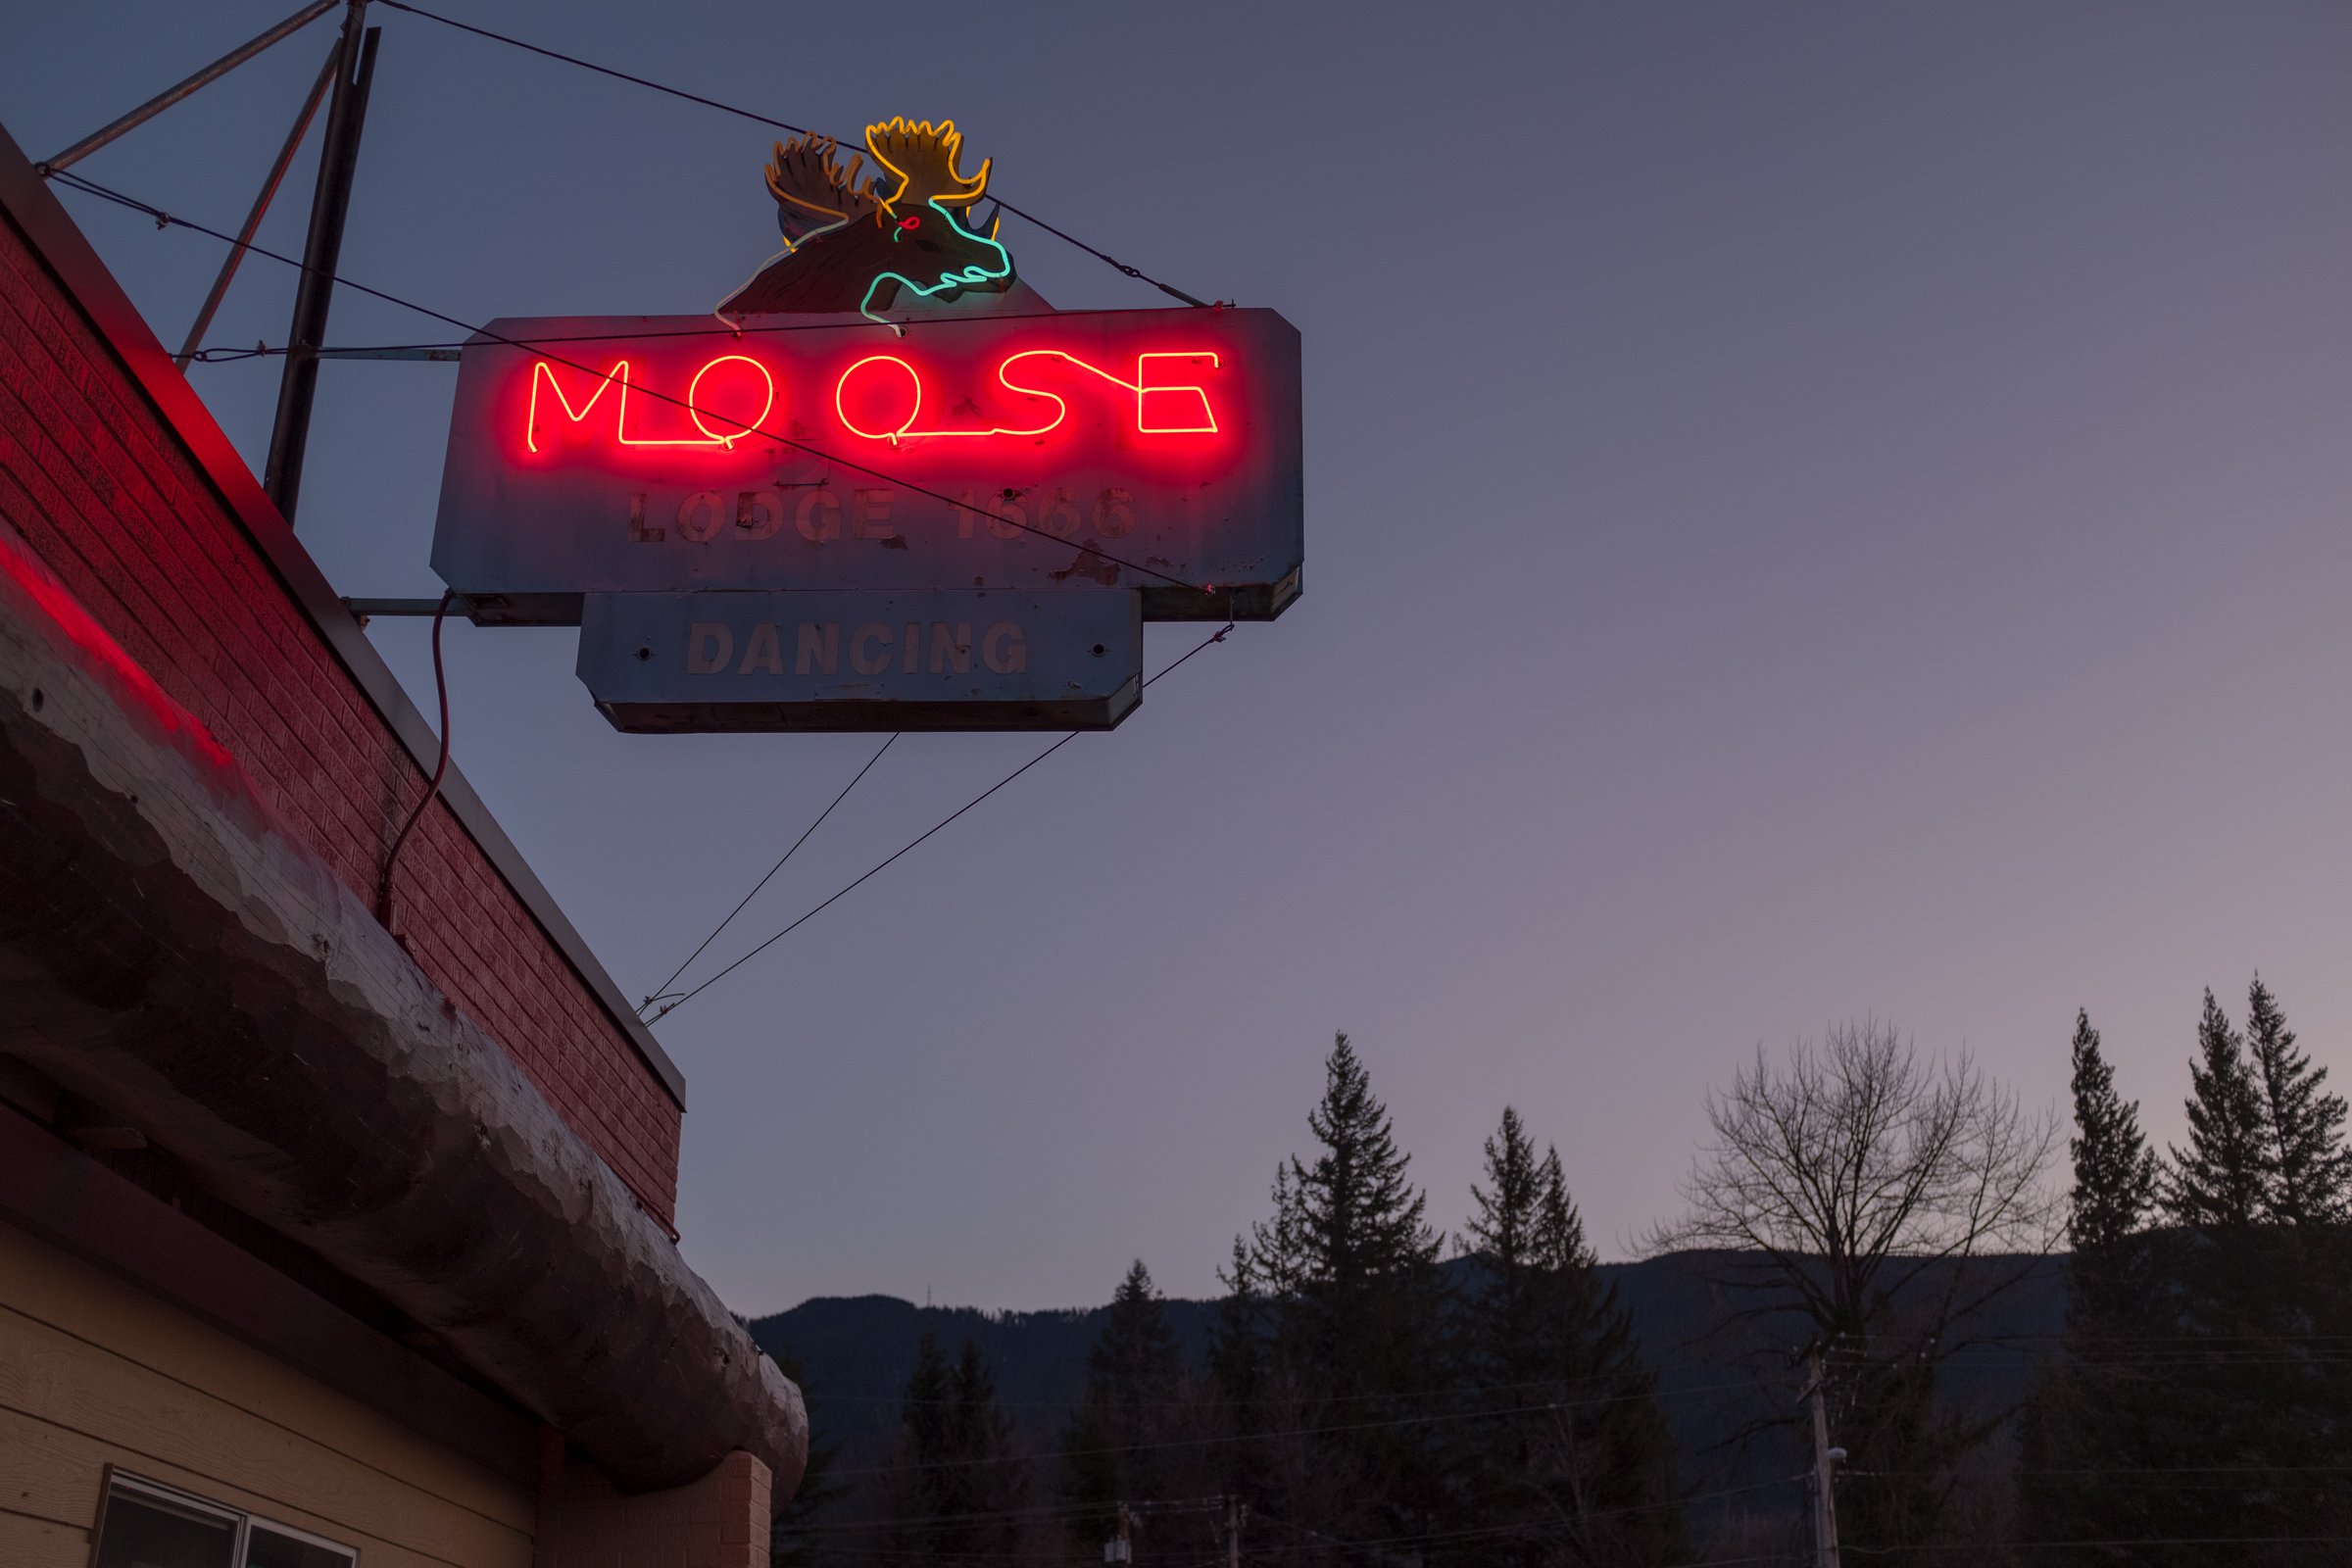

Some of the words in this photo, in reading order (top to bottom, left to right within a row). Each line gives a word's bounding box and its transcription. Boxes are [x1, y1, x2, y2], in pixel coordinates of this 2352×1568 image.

[525, 349, 1221, 453] MOOSE
[627, 488, 896, 544] LODGE
[948, 487, 1136, 540] 1666
[685, 620, 1028, 675] DANCING
